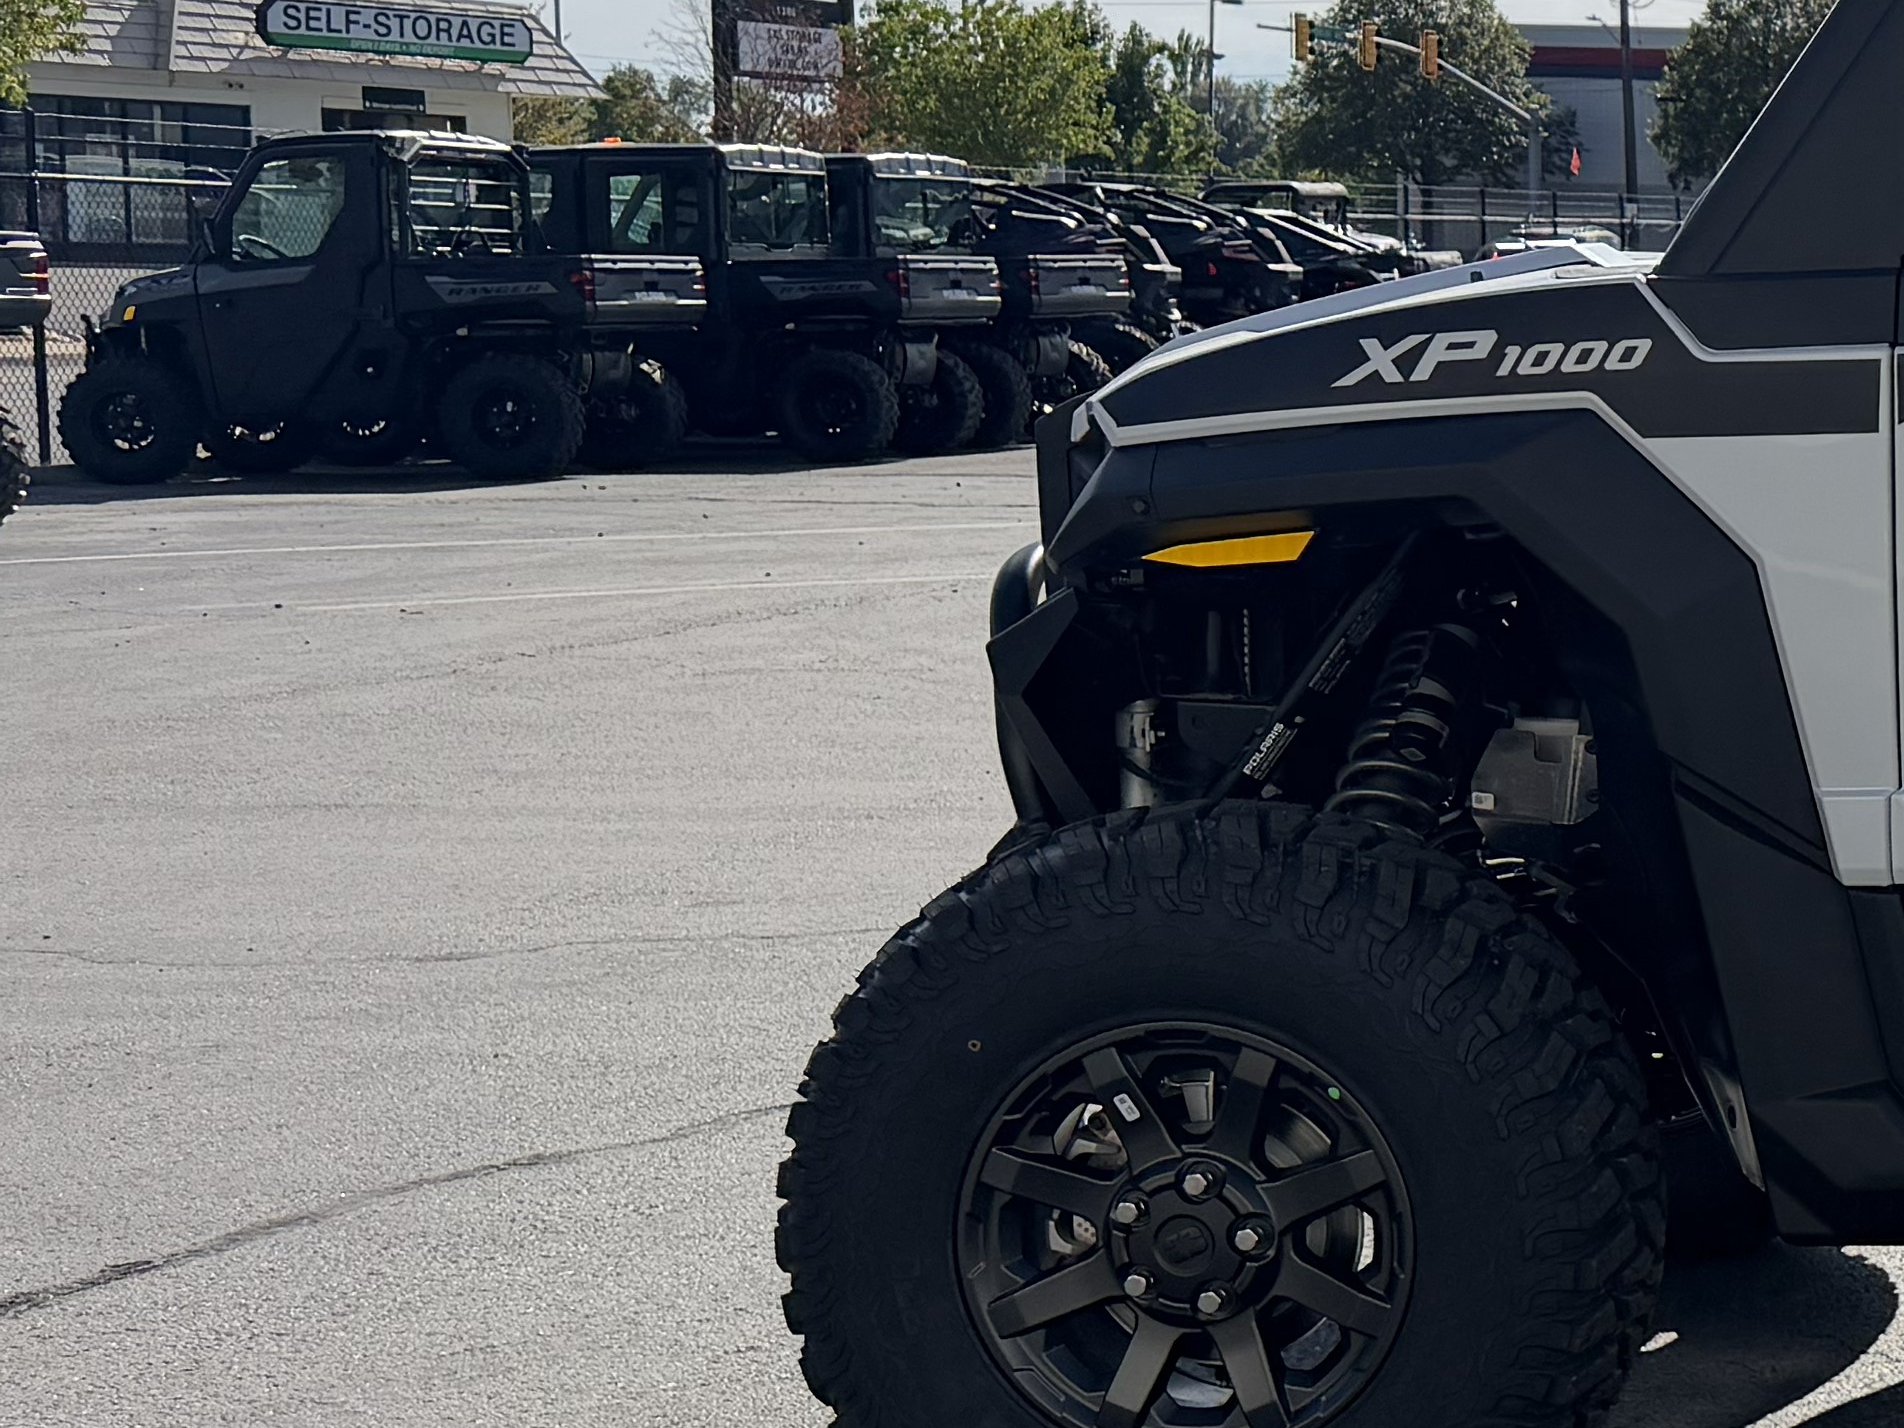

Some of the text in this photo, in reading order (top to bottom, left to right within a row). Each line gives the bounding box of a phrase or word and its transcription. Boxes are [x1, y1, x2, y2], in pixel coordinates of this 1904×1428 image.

[282, 4, 516, 47] SELF-STORAGE
[448, 282, 542, 296] RANGER
[1330, 329, 1653, 387] XP 1000
[1243, 722, 1284, 775] POLARIS
